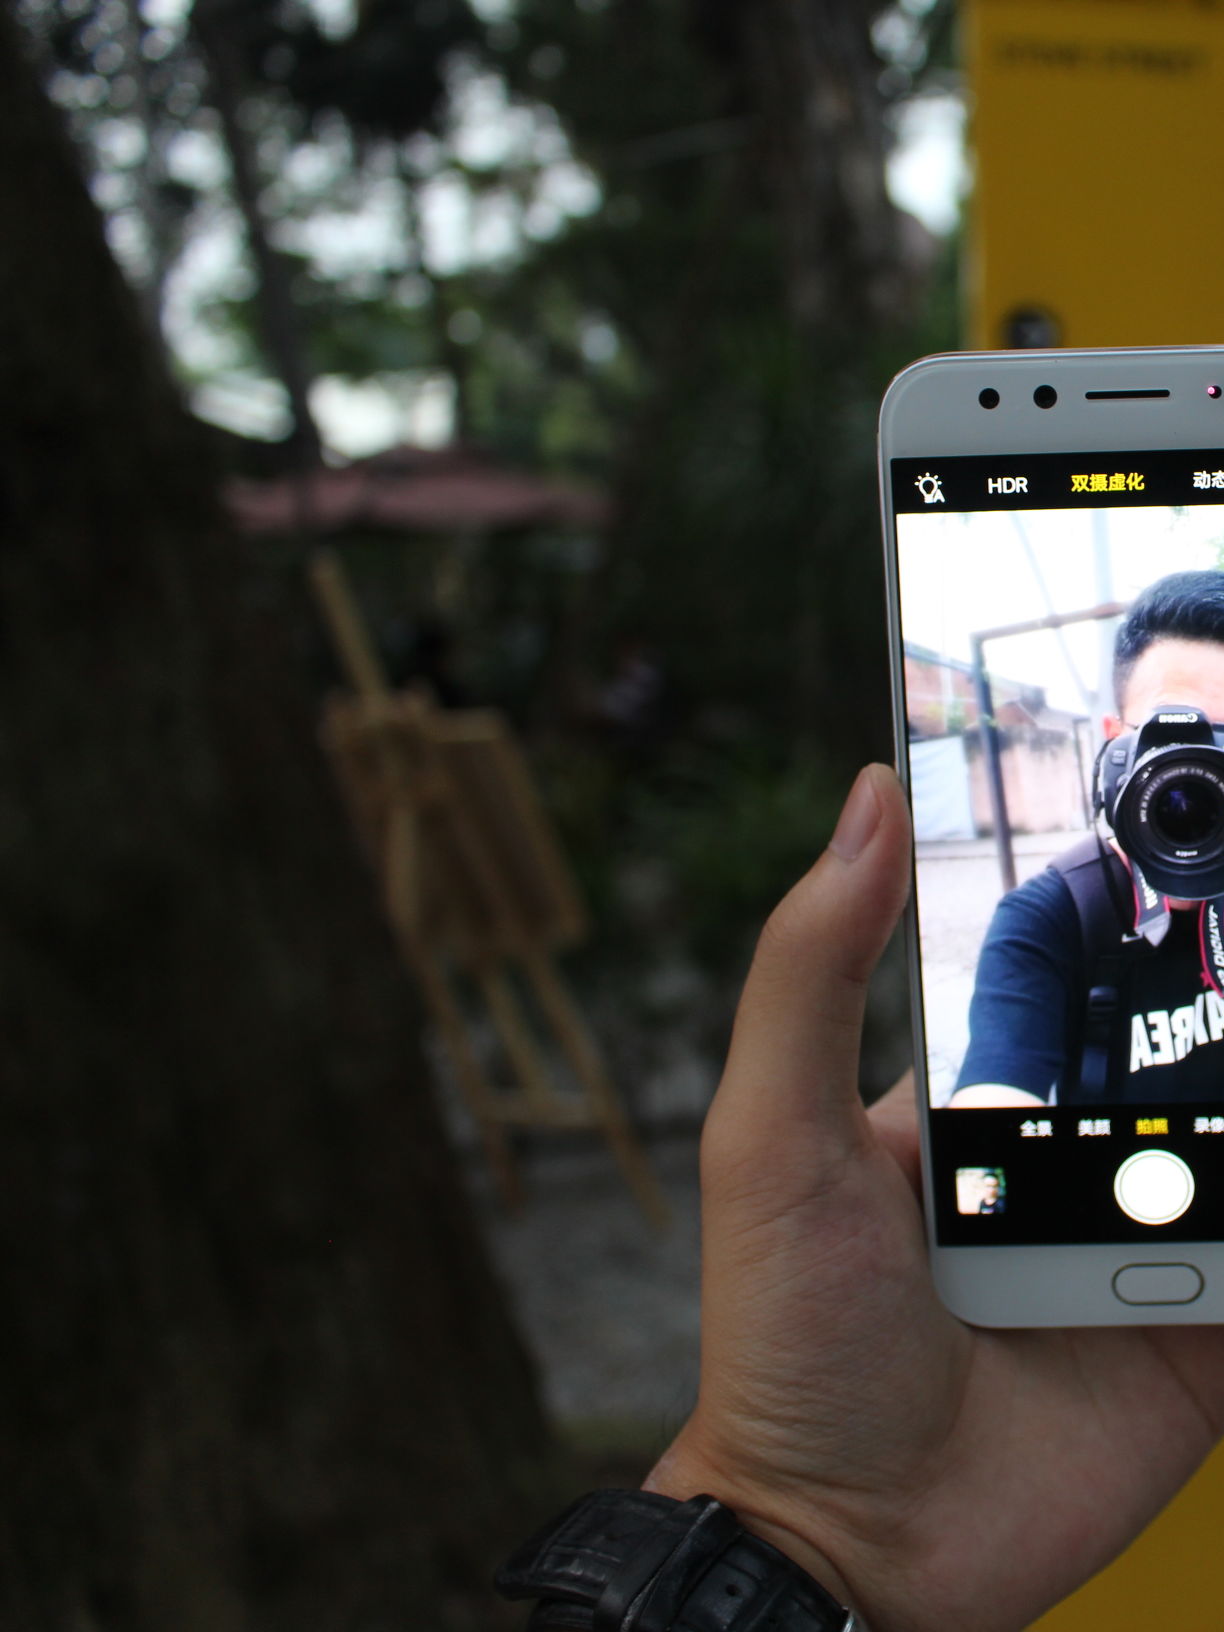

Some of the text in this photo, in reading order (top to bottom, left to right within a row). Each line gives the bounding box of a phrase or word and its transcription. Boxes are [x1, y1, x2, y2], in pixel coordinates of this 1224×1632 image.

[987, 476, 1029, 494] HDR
[1071, 472, 1145, 492] 双摄虚化
[1020, 1120, 1053, 1137] 全景
[1136, 1118, 1169, 1135] 拍照
